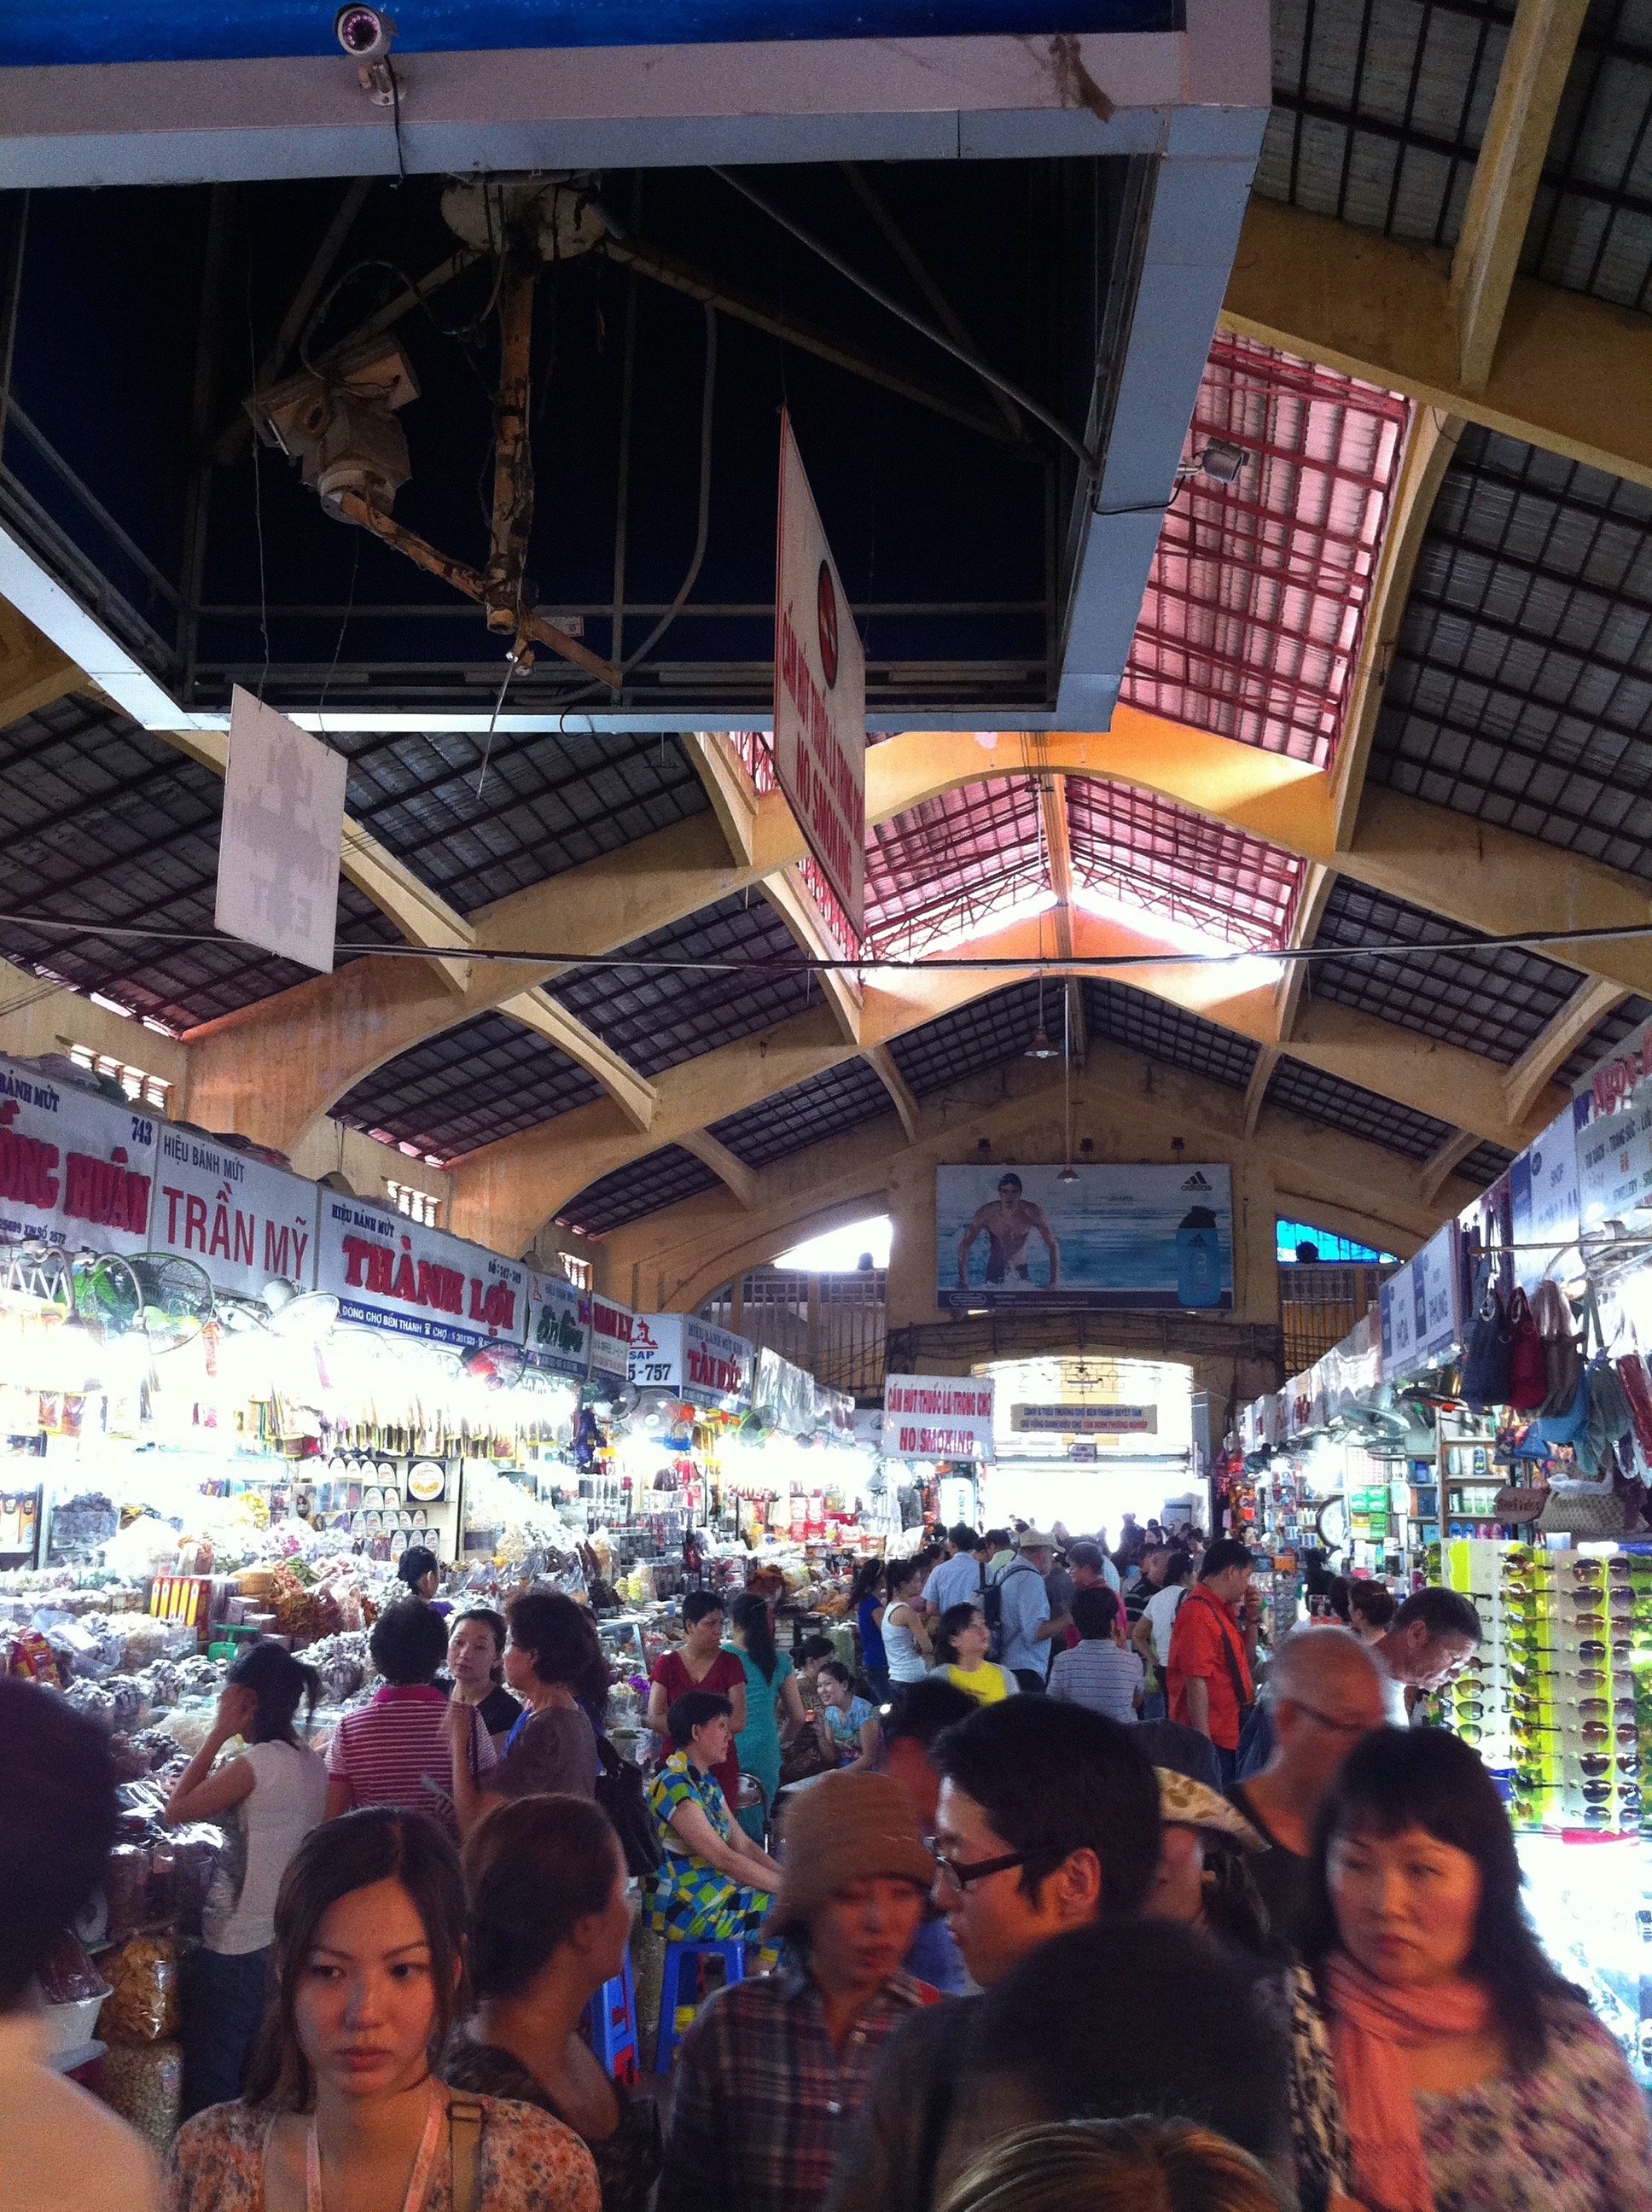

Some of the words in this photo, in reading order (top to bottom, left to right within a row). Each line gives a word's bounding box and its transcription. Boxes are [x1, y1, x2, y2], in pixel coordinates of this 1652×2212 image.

[796, 731, 810, 813] NO
[813, 769, 852, 897] SMOKING
[131, 1116, 152, 1145] 743
[164, 1135, 188, 1165] HIỆU
[192, 1144, 220, 1174] BÁNH
[224, 1156, 245, 1183] MỨT
[162, 1181, 254, 1266] TRẦN
[265, 1216, 308, 1280] MỸ
[332, 1202, 352, 1225] HIỆU
[354, 1209, 375, 1231] BÁNH
[342, 1234, 465, 1315] THÀNH
[468, 1279, 516, 1336] LỢI
[366, 1312, 382, 1326] CHỢ
[383, 1313, 398, 1328] BẾN
[398, 1318, 422, 1333] THÀNH
[687, 1342, 716, 1388] TÀI
[899, 1427, 916, 1452] NO
[920, 1428, 974, 1455] SMOKING
